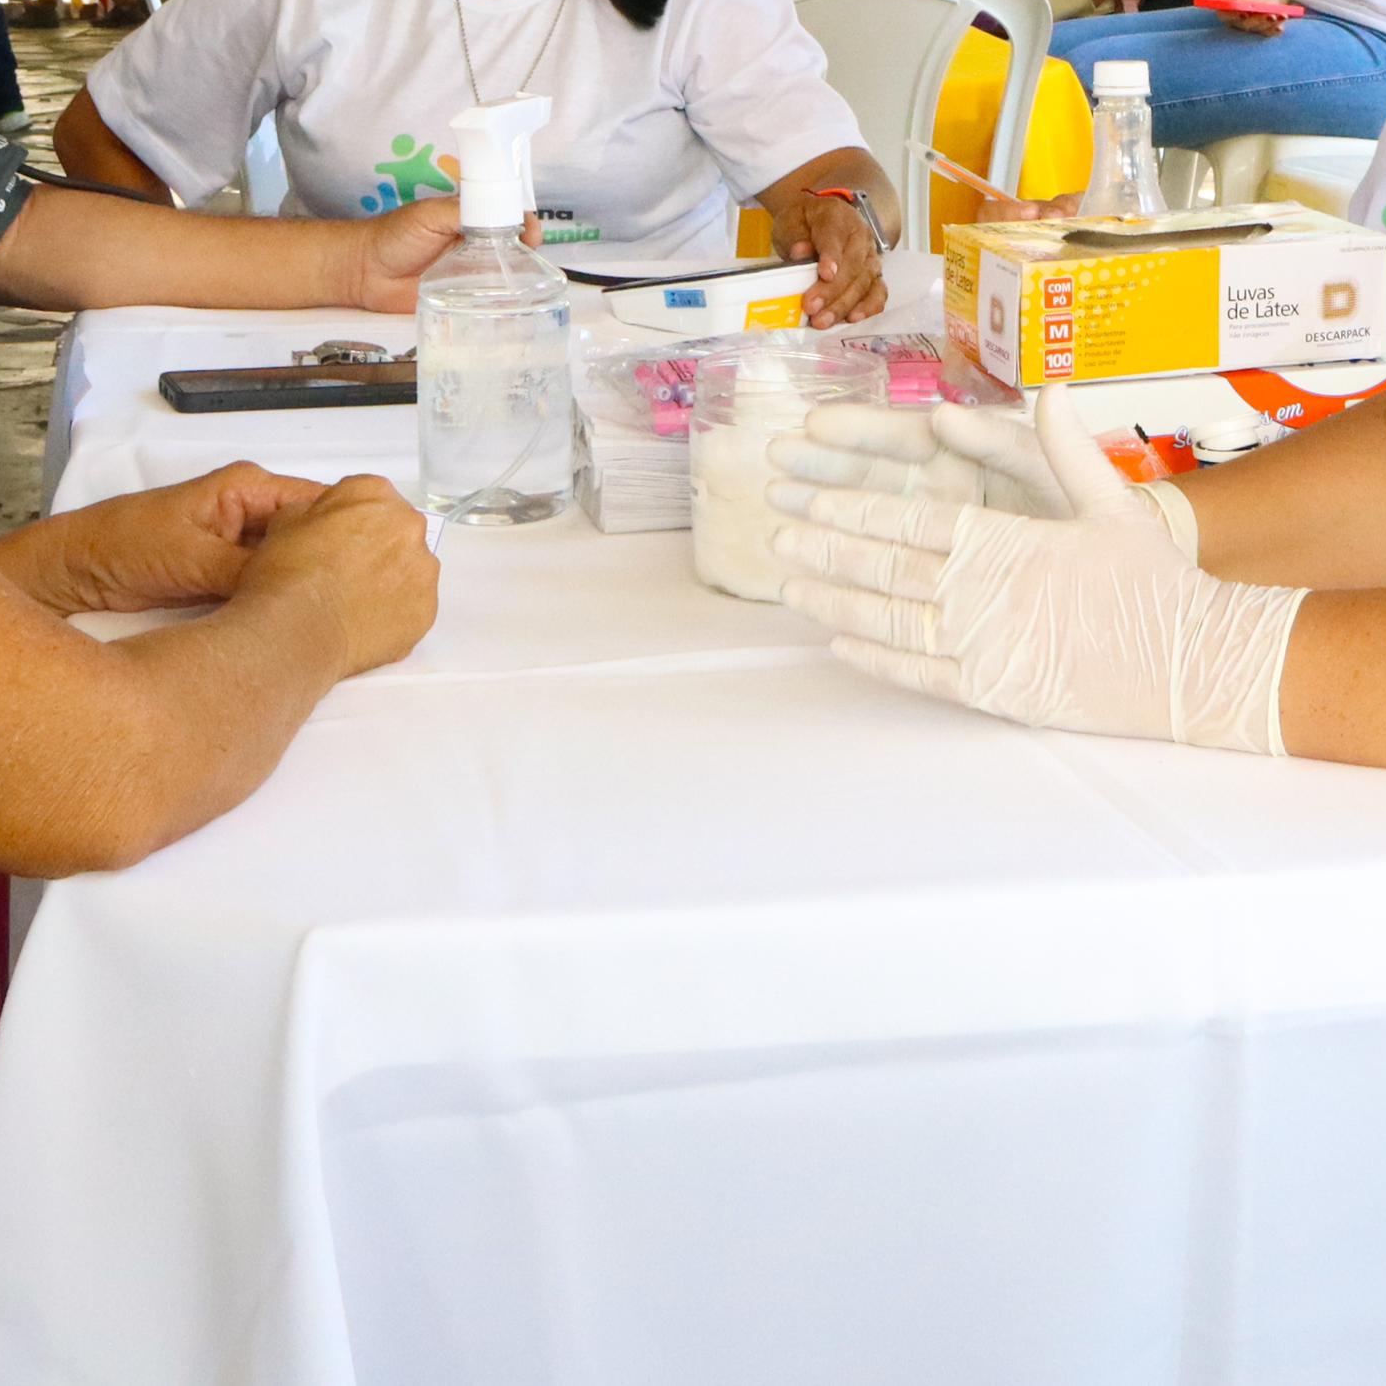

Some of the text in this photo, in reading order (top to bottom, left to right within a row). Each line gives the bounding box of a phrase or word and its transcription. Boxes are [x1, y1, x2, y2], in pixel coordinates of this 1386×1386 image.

[543, 223, 600, 244] ania
[1047, 282, 1072, 294] COM
[1227, 286, 1275, 302] Luvas
[1053, 293, 1067, 306] PÓ
[1227, 300, 1300, 320] de Látex
[1049, 324, 1070, 340] M
[1305, 326, 1371, 344] DESCARPACK
[1046, 353, 1072, 369] 100
[1277, 401, 1305, 421] em
